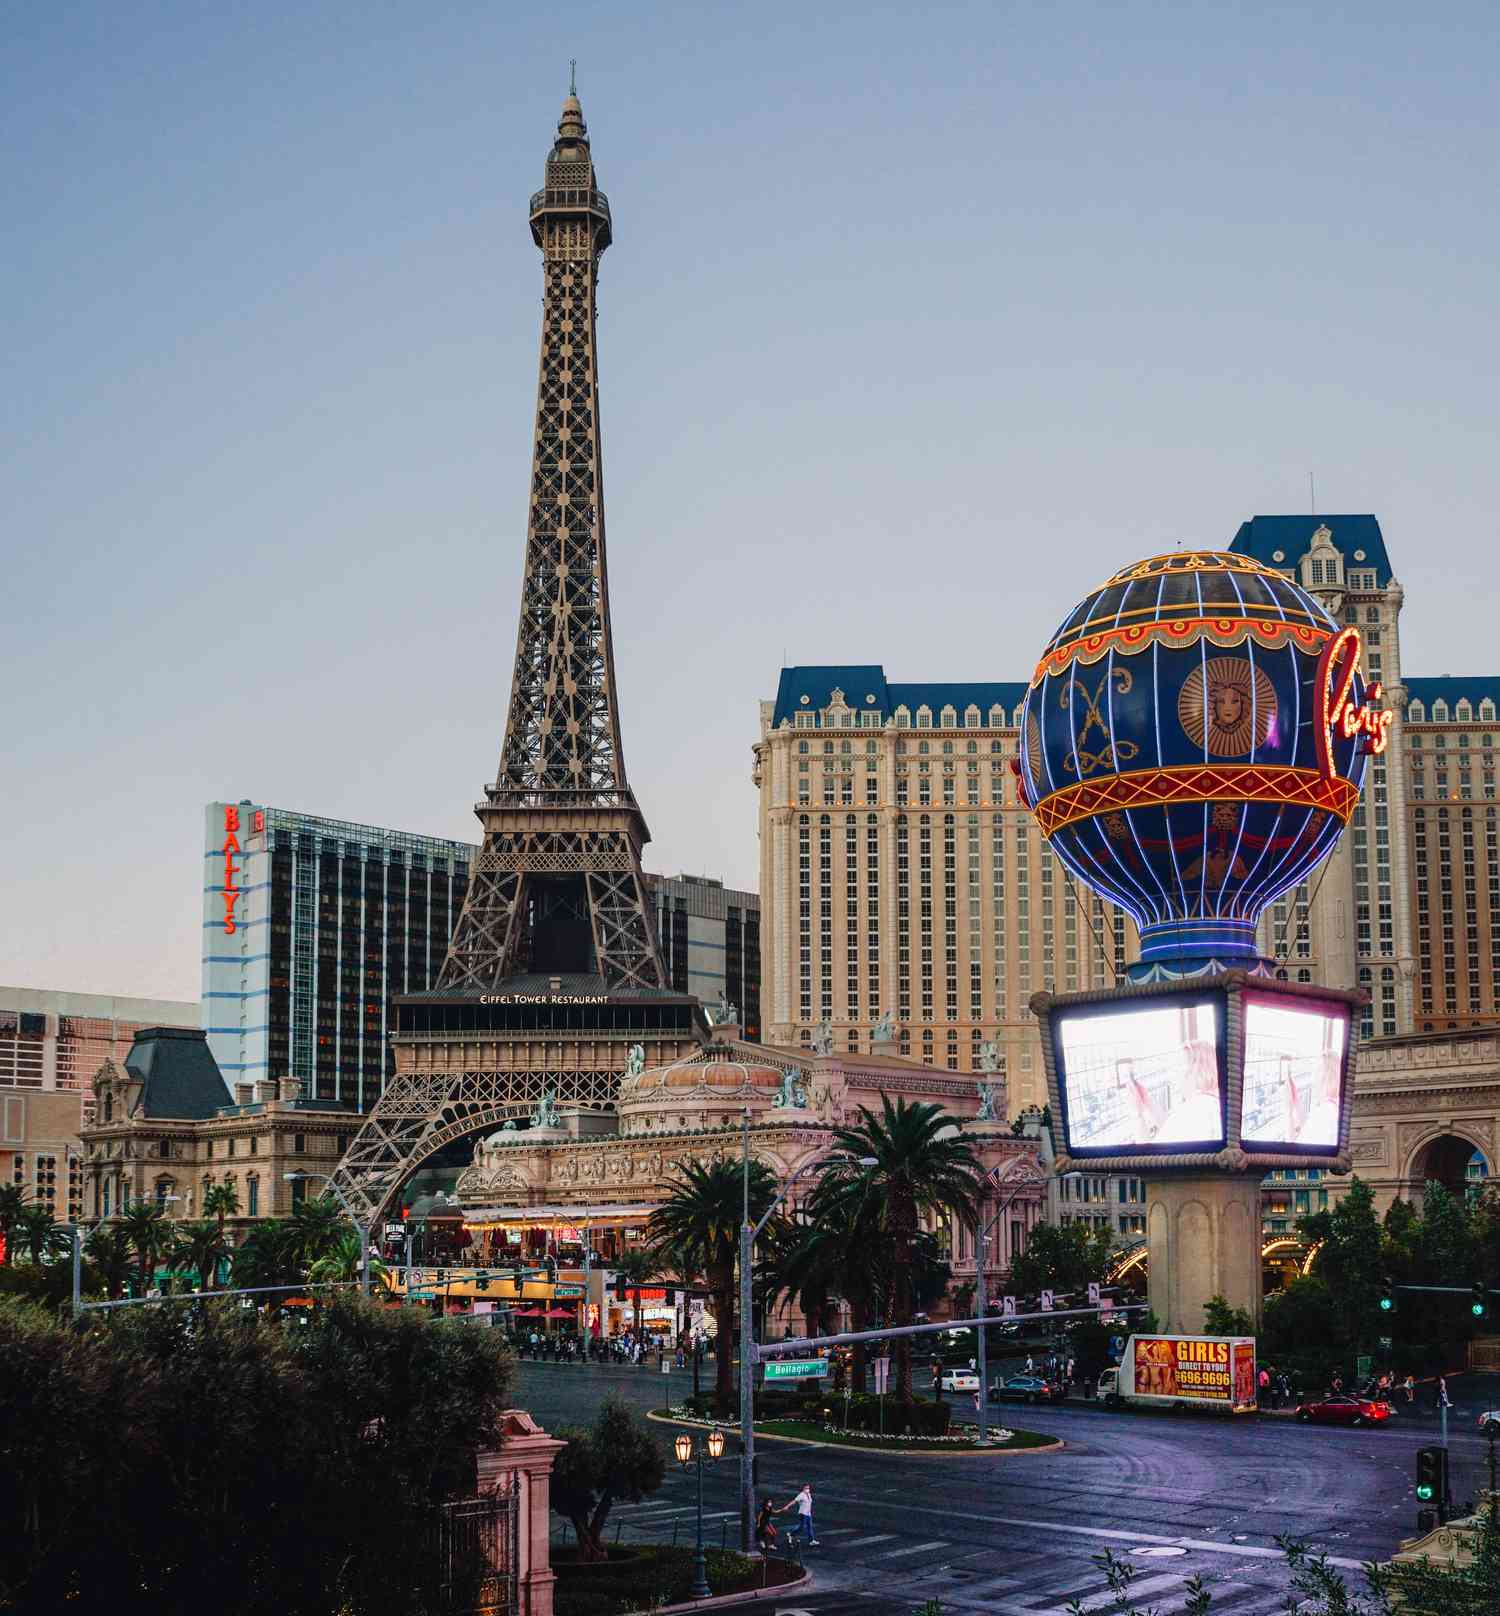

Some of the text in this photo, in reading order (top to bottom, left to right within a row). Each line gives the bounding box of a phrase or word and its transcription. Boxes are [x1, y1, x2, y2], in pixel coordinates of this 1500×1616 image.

[1313, 626, 1394, 780] Paris
[480, 993, 609, 1005] EIFFEL TOWER RESTAURANT
[1176, 1341, 1228, 1363] GIRLS
[1178, 1361, 1201, 1371] DIRECT
